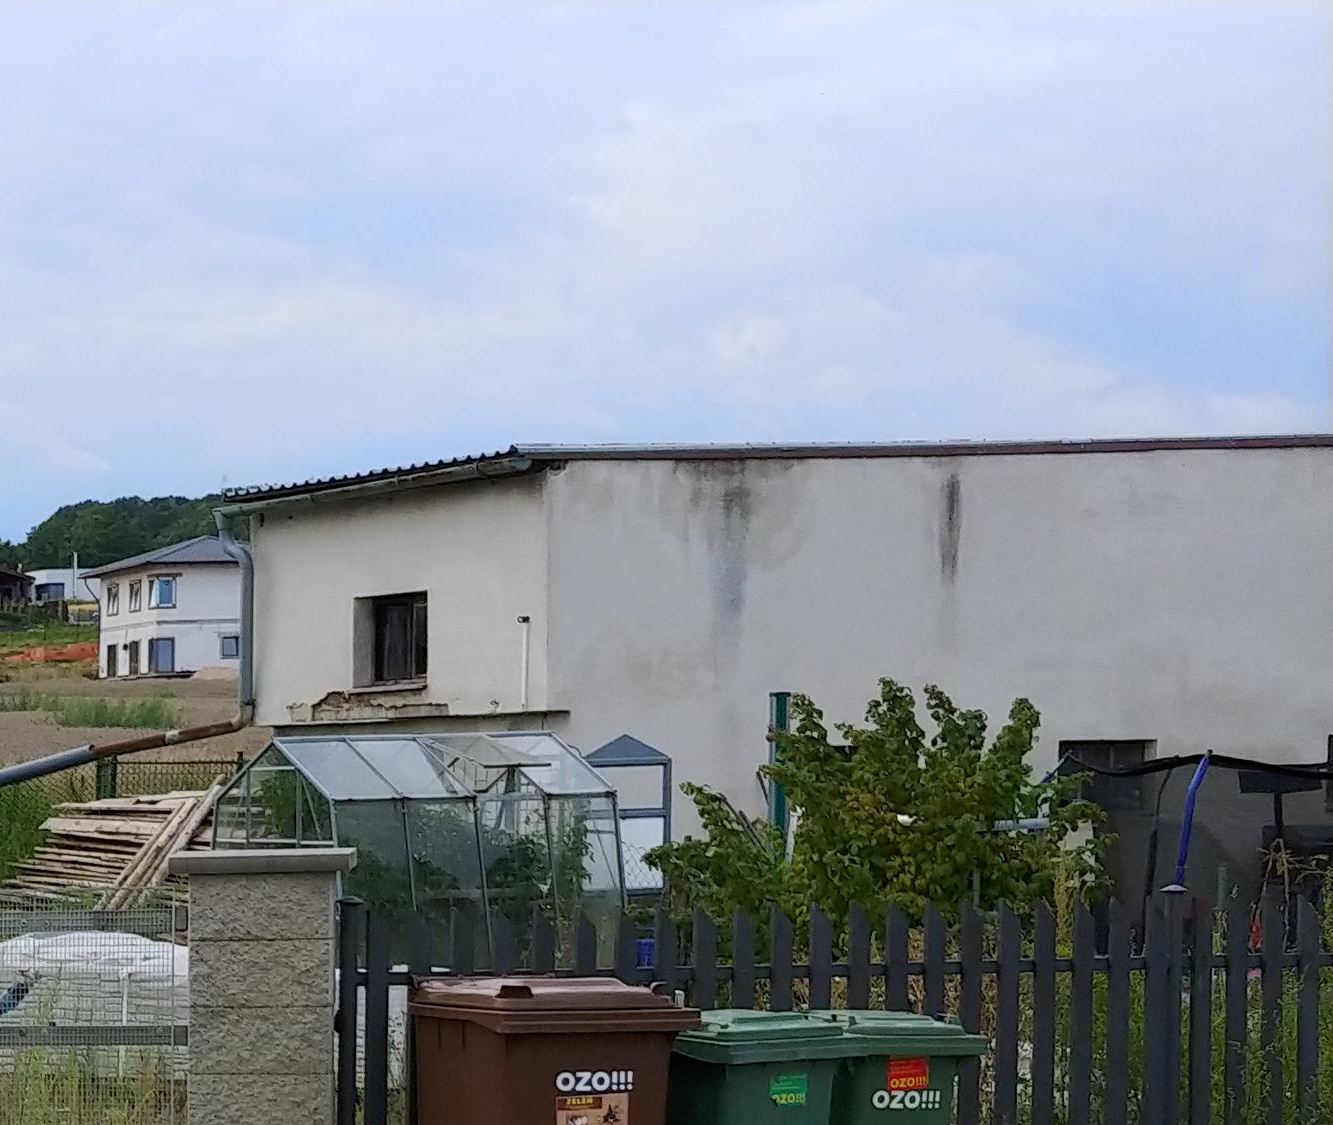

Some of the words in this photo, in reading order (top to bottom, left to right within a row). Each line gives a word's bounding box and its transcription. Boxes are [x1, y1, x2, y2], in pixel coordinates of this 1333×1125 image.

[556, 1071, 633, 1092] OZO!!!
[890, 1076, 926, 1089] OZO!!!
[872, 1090, 940, 1109] OZO!!!
